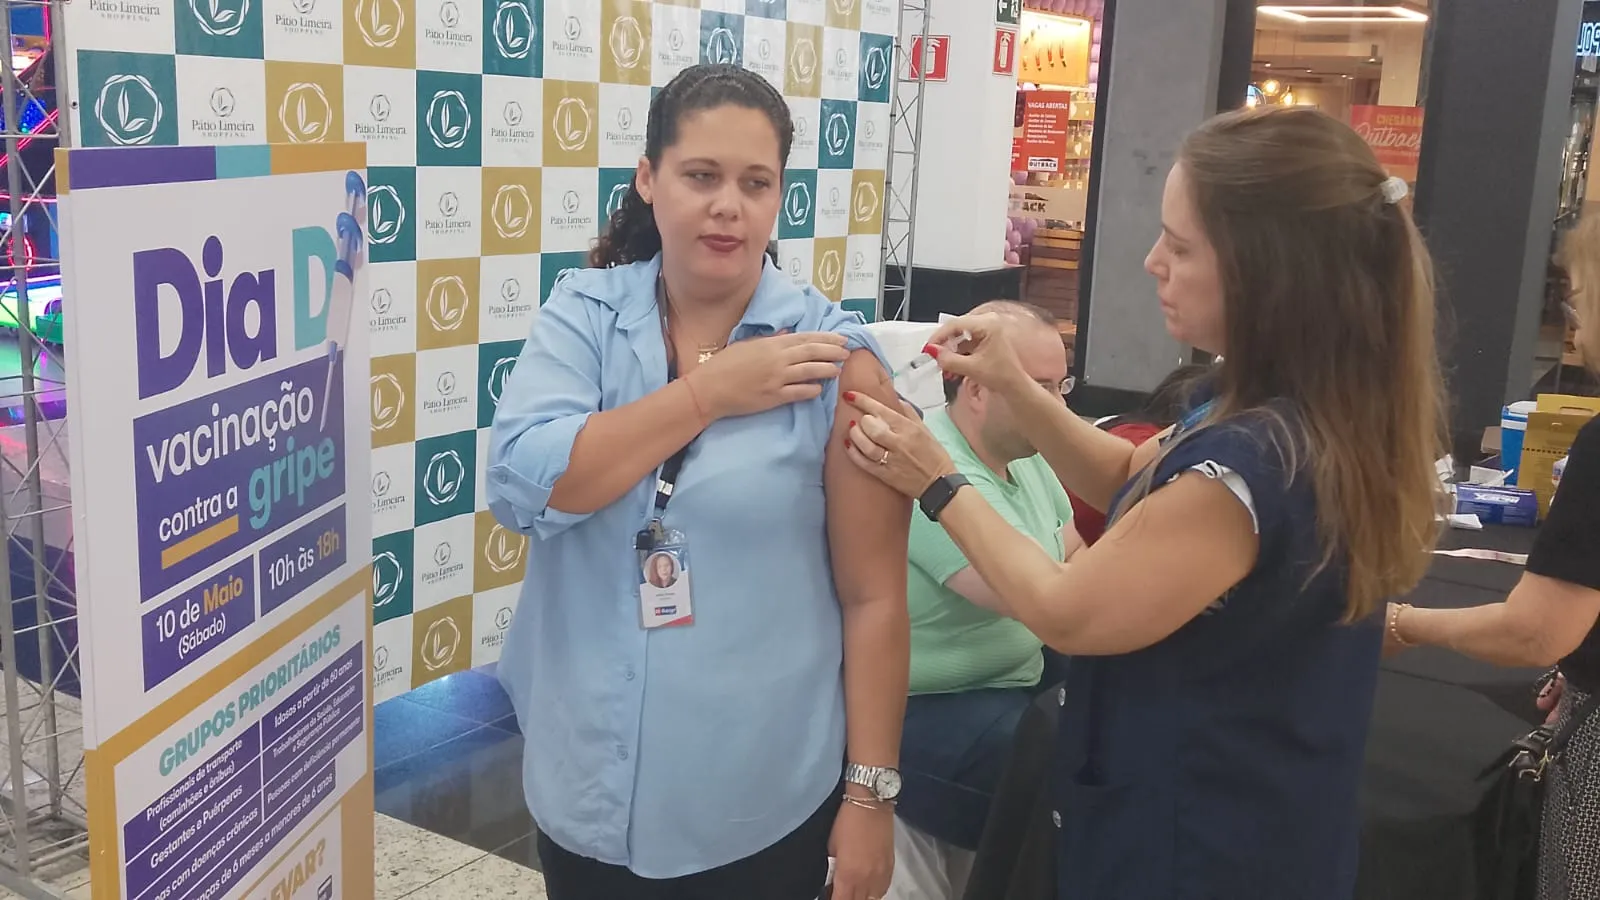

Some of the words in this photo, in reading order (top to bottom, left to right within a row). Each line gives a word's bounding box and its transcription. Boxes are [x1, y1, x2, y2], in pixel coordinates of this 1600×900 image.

[119, 2, 160, 16] Limeira
[299, 16, 332, 30] Limeira
[446, 30, 473, 42] Limeira
[191, 119, 217, 131] Pátio
[218, 120, 255, 132] Limeira
[376, 125, 407, 136] Limeira
[508, 128, 535, 138] Limeira
[445, 217, 471, 229] Limeira
[132, 235, 278, 400] Dia
[292, 226, 338, 351] D
[377, 315, 407, 327] Limeira
[146, 381, 314, 482] vacinação
[159, 494, 222, 542] contra
[226, 486, 239, 509] a
[248, 436, 335, 529] gripe
[268, 559, 295, 590] 10h
[297, 546, 315, 573] às
[316, 529, 340, 561] 18h
[156, 610, 176, 643] 10
[179, 599, 200, 629] de
[203, 575, 244, 616] Maio
[178, 612, 226, 660] (Sábado)
[159, 702, 236, 777] GRUPOS
[238, 624, 341, 720] PRIORITÁRIOS
[274, 704, 297, 728] Idosos
[297, 699, 302, 709] a
[302, 683, 321, 708] partir
[321, 676, 329, 690] de
[330, 668, 338, 683] 60
[338, 659, 353, 677] anos
[146, 776, 196, 821] Profissionais
[196, 768, 206, 782] de
[206, 740, 243, 773] transporte
[160, 788, 203, 831] (caminhões
[203, 784, 209, 794] e
[209, 760, 235, 789] ônibus)
[150, 824, 196, 869] Gestantes
[196, 819, 202, 830] e
[203, 784, 243, 825] Puérperas
[171, 868, 191, 891] com
[191, 836, 226, 873] doenças
[226, 807, 258, 842] crônicas
[221, 868, 232, 884] de
[232, 859, 239, 873] 6
[239, 838, 264, 867] meses
[264, 832, 270, 843] a
[271, 802, 302, 838] menores
[301, 794, 311, 808] de
[312, 785, 317, 798] 6
[317, 772, 333, 794] anos
